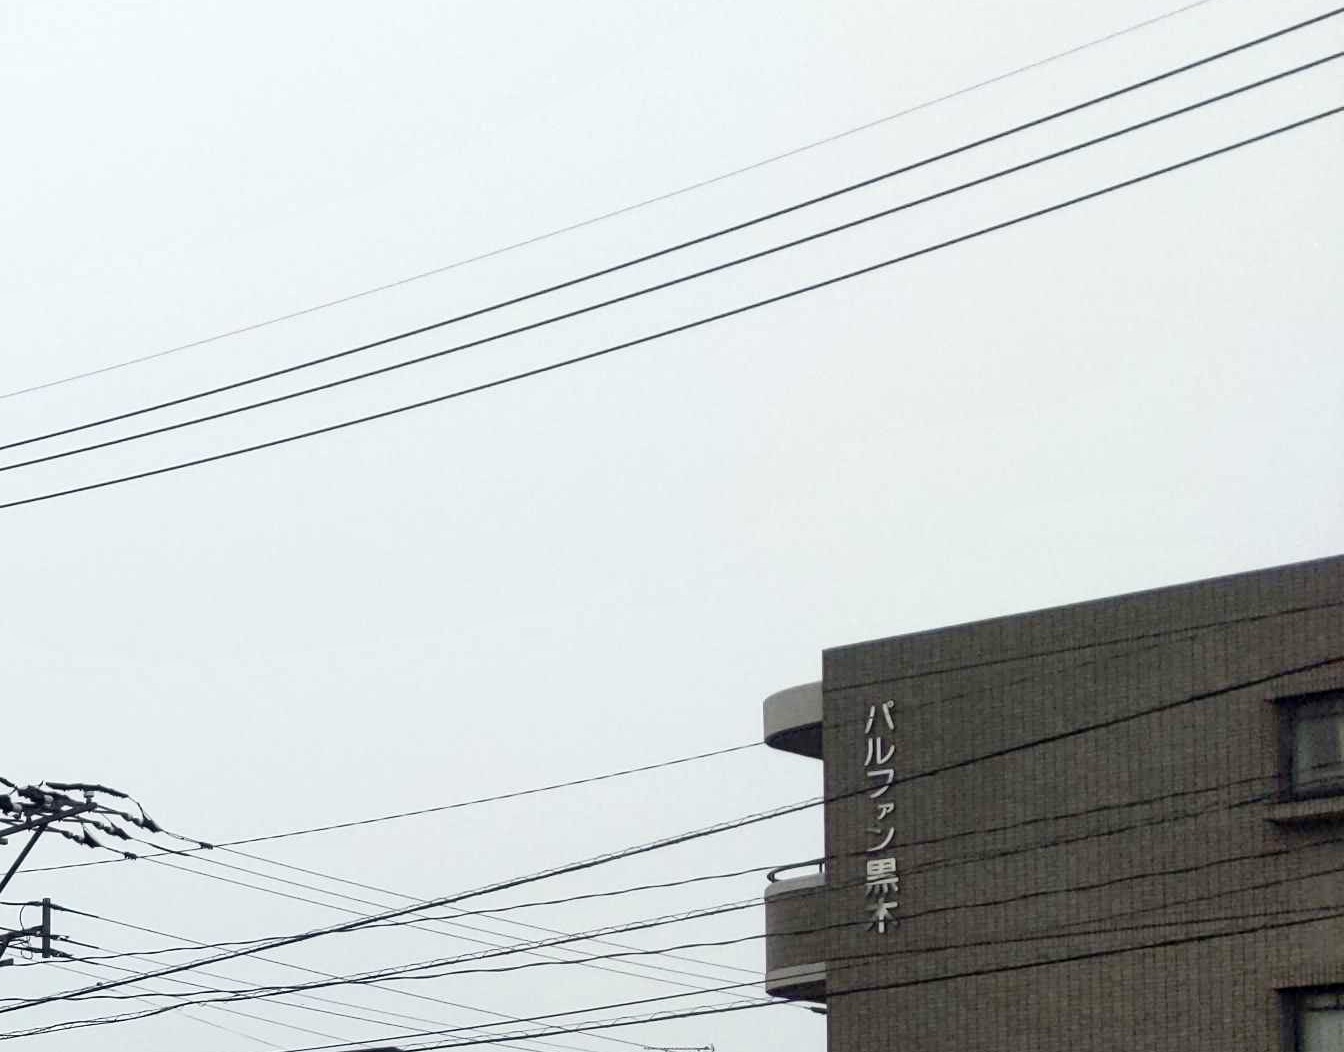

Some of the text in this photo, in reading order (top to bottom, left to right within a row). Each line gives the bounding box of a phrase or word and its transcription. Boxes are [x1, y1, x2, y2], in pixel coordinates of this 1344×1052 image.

[863, 699, 900, 934] パルファン黒木
